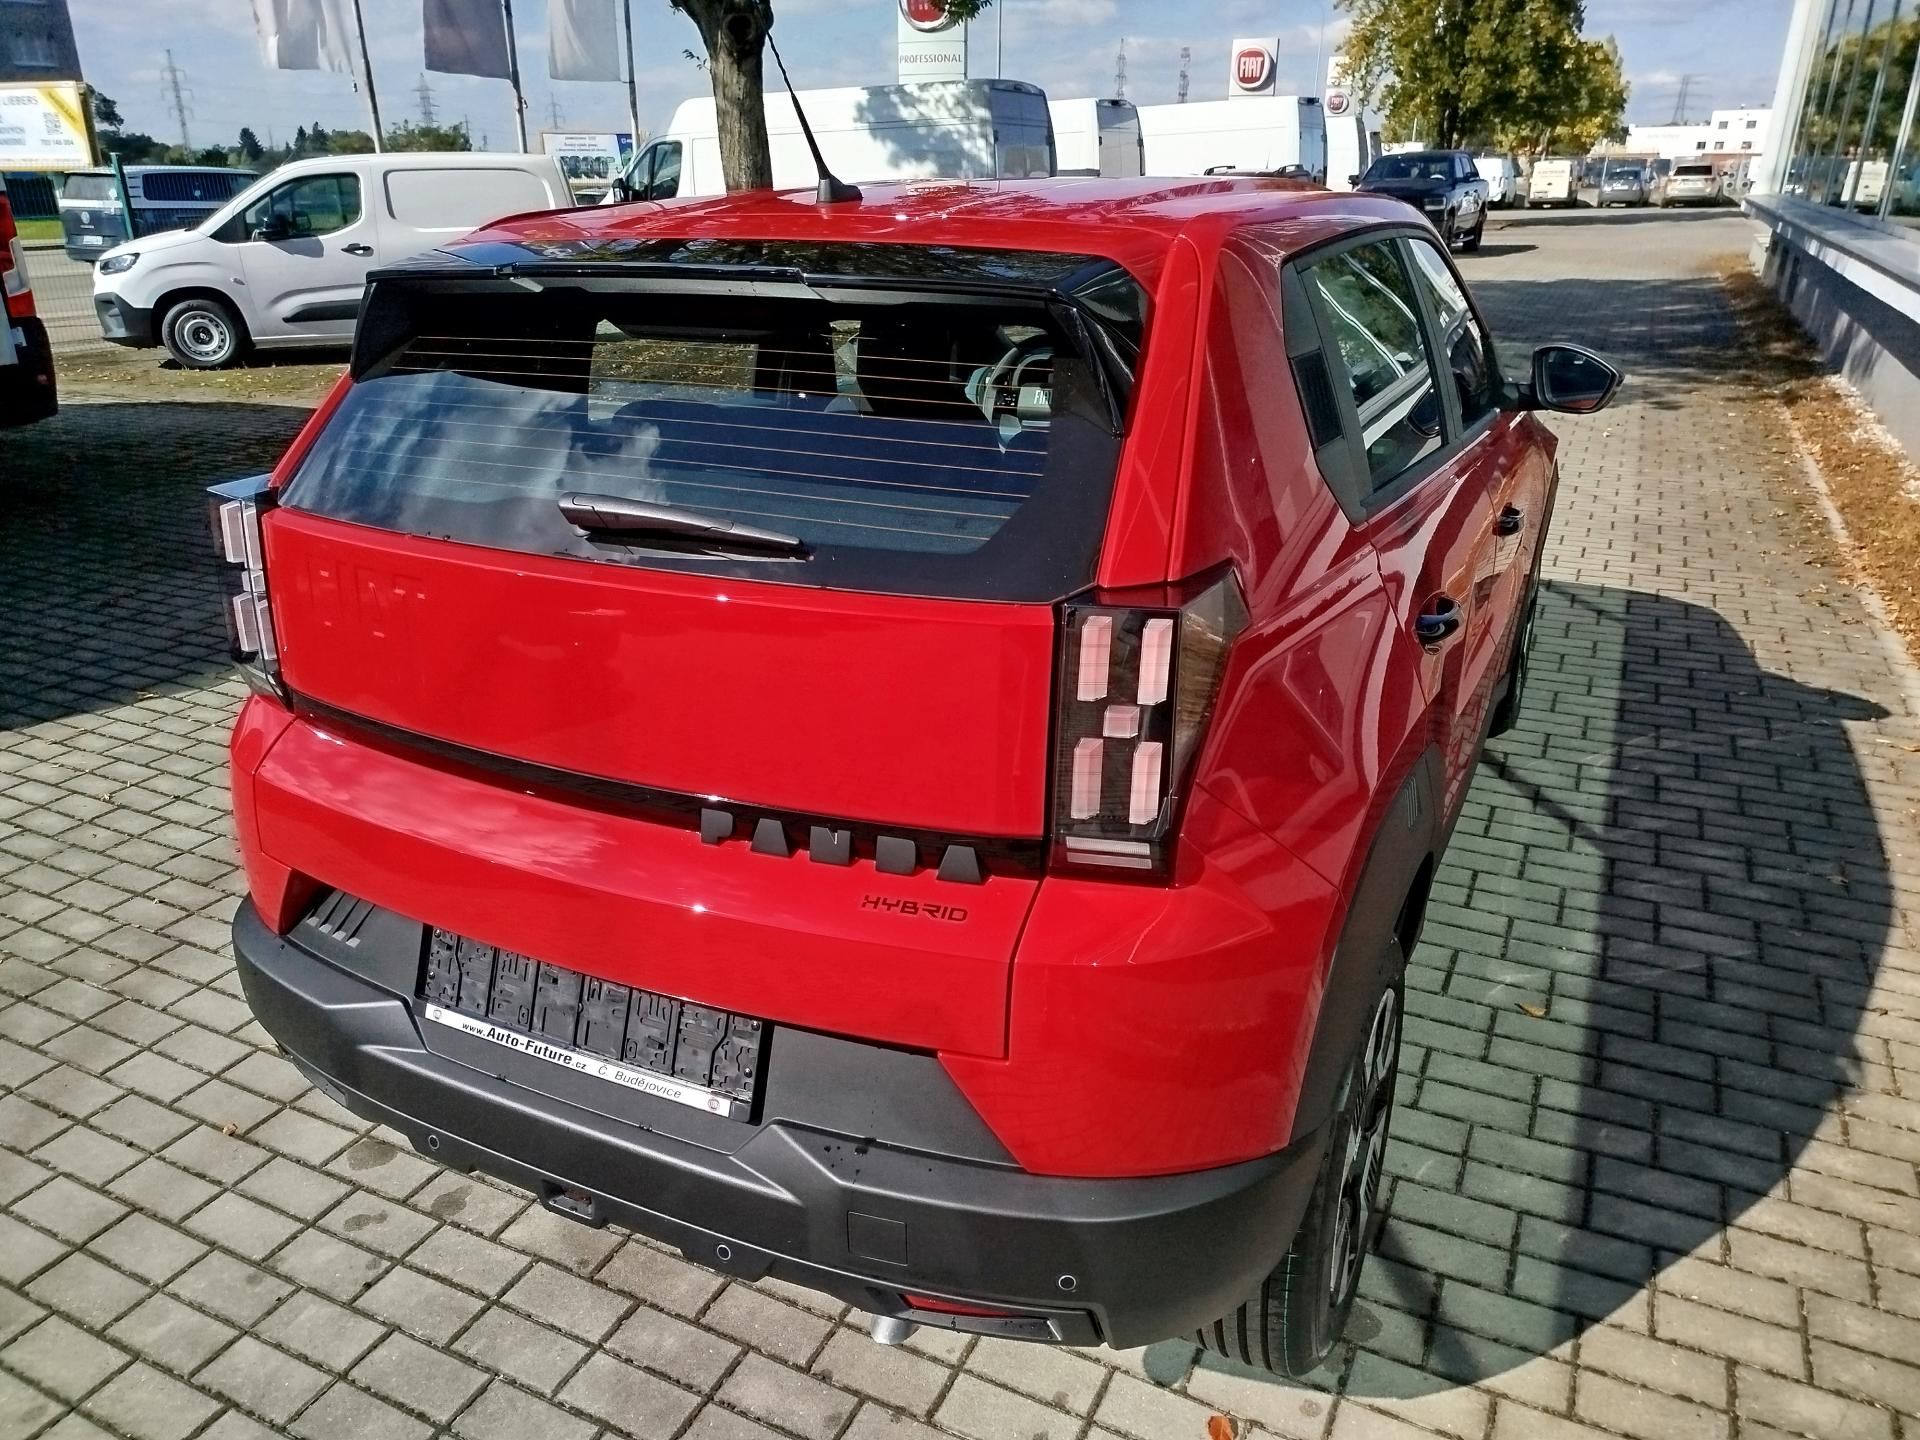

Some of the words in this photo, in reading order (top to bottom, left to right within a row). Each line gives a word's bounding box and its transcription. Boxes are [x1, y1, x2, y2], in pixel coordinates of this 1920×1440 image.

[899, 54, 963, 64] PROFESSIONAL
[1239, 56, 1264, 79] FIAT
[1033, 389, 1053, 405] FIAT
[700, 807, 982, 884] PANDA
[861, 894, 969, 922] HYBRID
[462, 1022, 587, 1071] www.Auto-Future.cz
[598, 1064, 608, 1076] Č.
[614, 1069, 683, 1099] Budějovice
